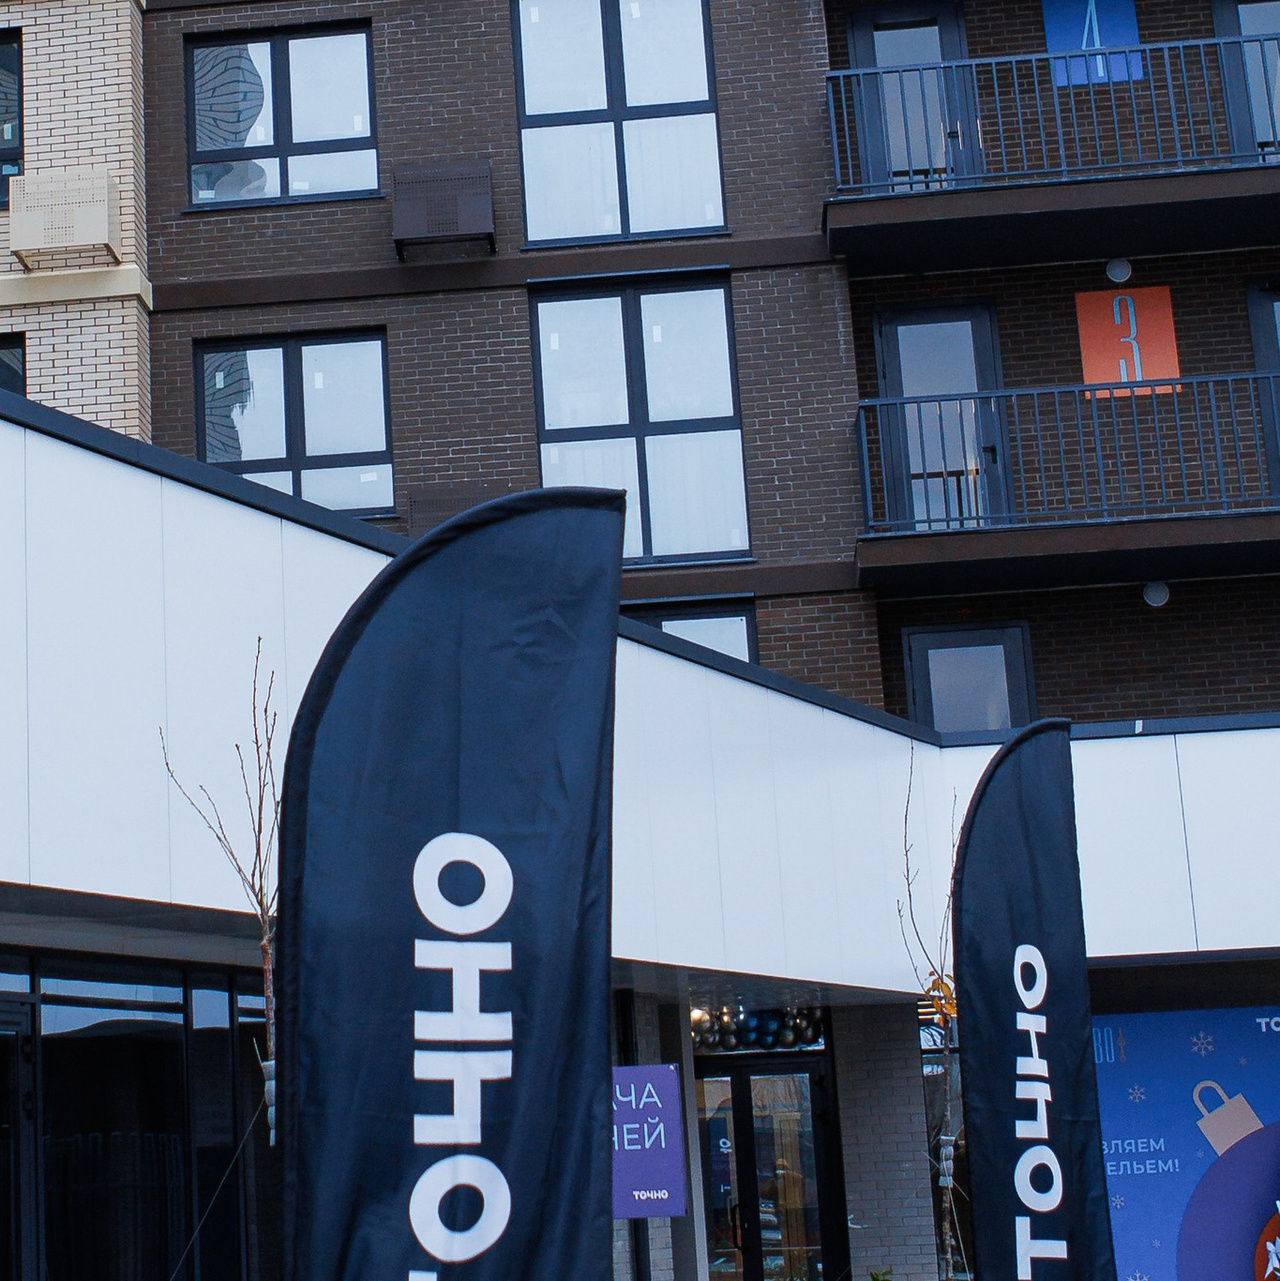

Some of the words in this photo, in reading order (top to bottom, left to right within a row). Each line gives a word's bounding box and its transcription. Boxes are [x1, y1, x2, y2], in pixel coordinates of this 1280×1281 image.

[1112, 295, 1143, 391] 3
[612, 1082, 663, 1111] ЧА
[1013, 943, 1068, 1281] ТОЧНО
[632, 1189, 669, 1201] ТОЧНО
